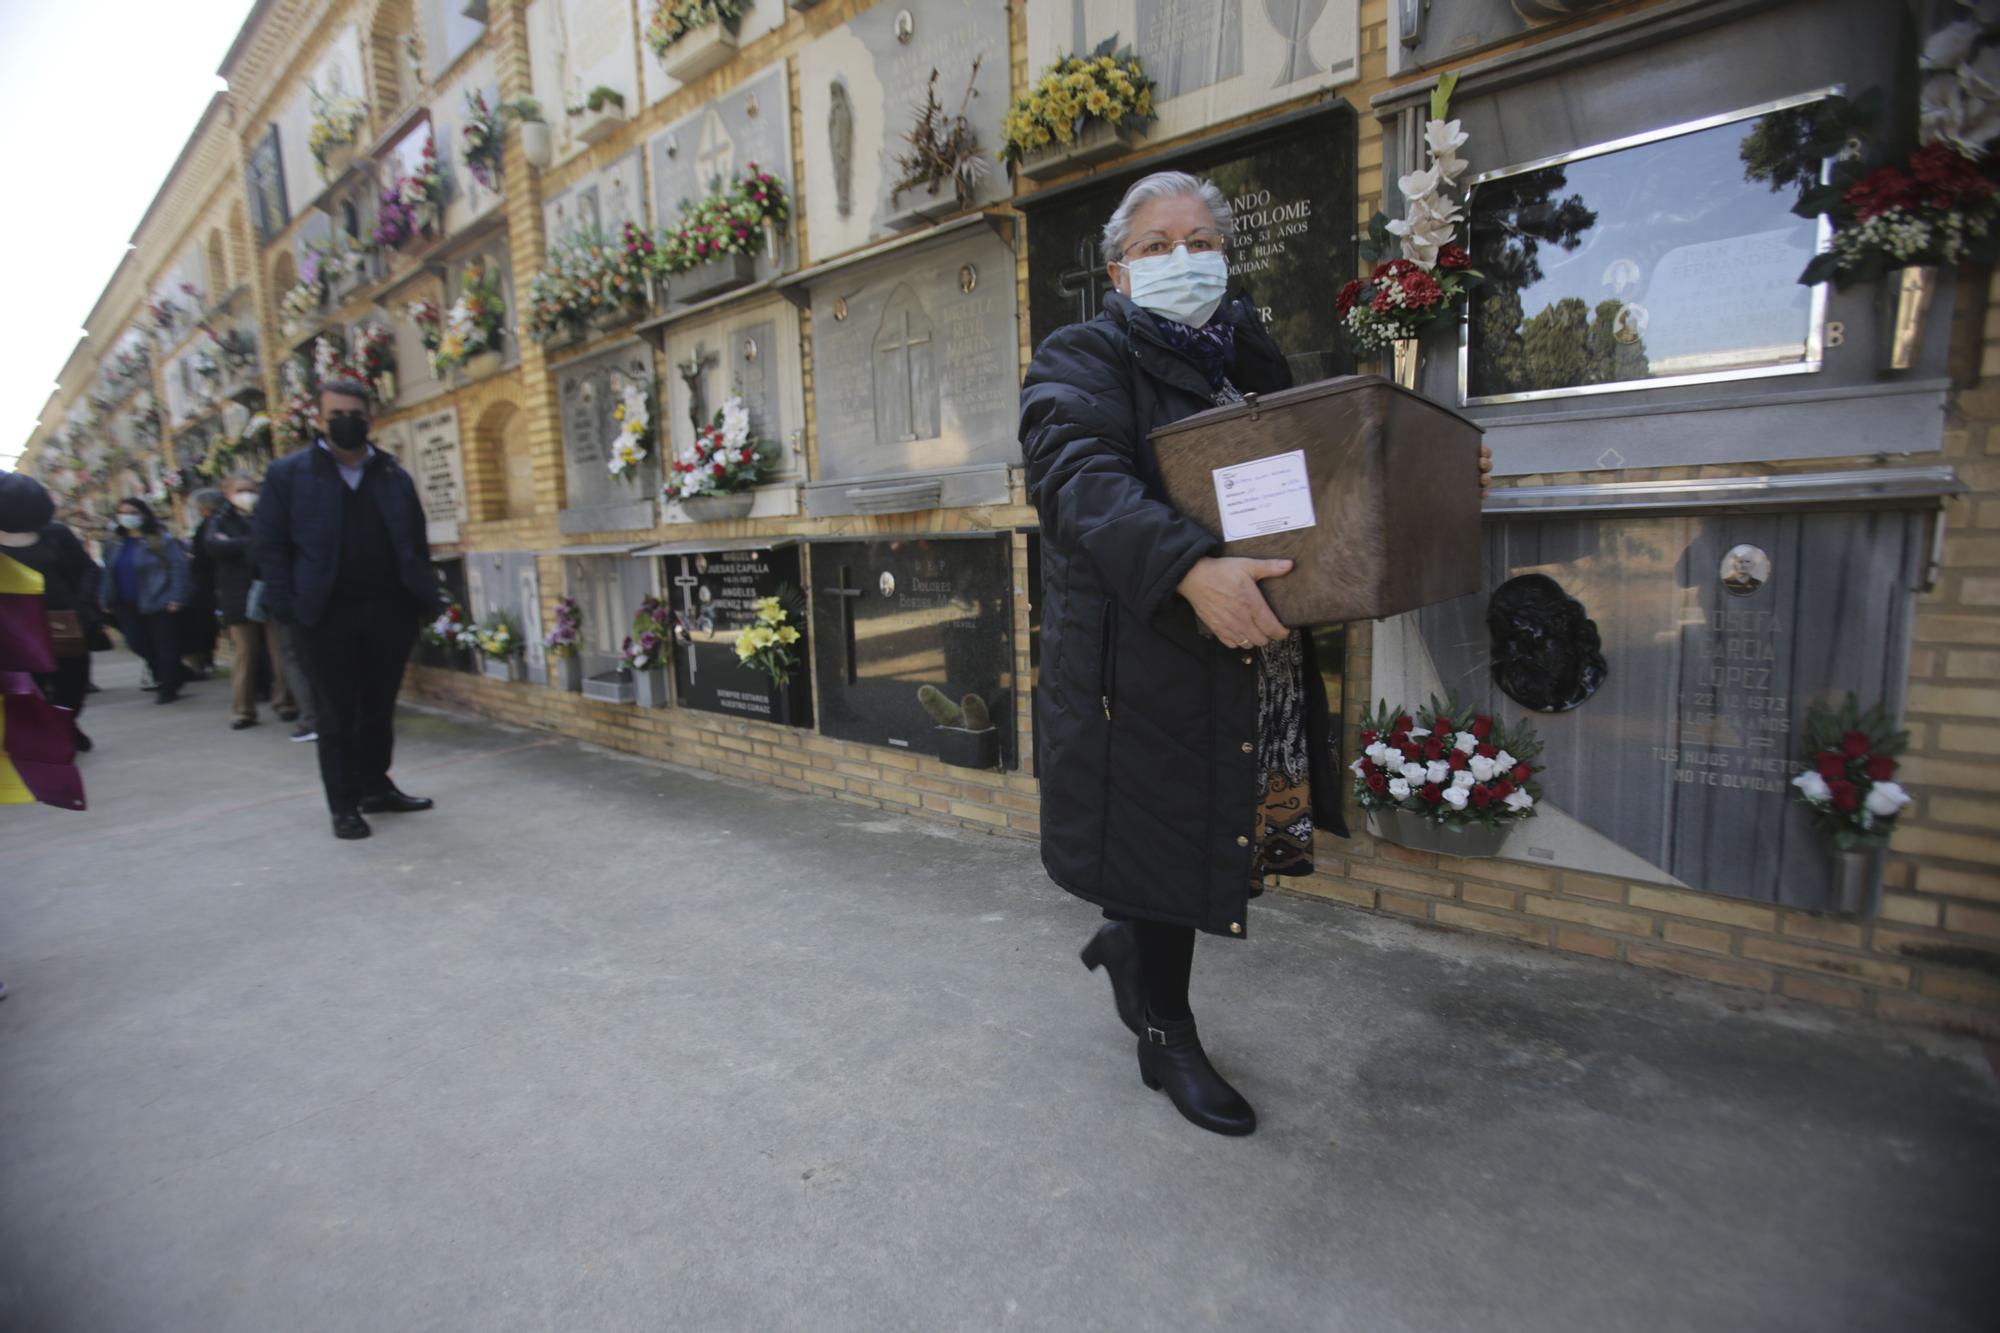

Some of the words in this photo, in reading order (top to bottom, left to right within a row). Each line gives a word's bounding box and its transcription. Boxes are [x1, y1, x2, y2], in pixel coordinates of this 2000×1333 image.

[1233, 233, 1253, 248] LOS
[1258, 230, 1271, 242] 53
[1276, 220, 1309, 239] AÑOS
[1255, 240, 1286, 258] HIJAS
[1671, 249, 1788, 280] FERNANDEZ
[736, 562, 770, 574] CAPILLA
[722, 587, 757, 597] ANGELES
[1696, 665, 1772, 690] LOPEZ
[1652, 746, 1679, 762] TUS
[1684, 750, 1730, 768] HIJOS
[1735, 755, 1745, 768] Y
[1674, 768, 1695, 784] NO
[1699, 771, 1718, 786] TE
[1721, 773, 1787, 793] OLVIDAN
